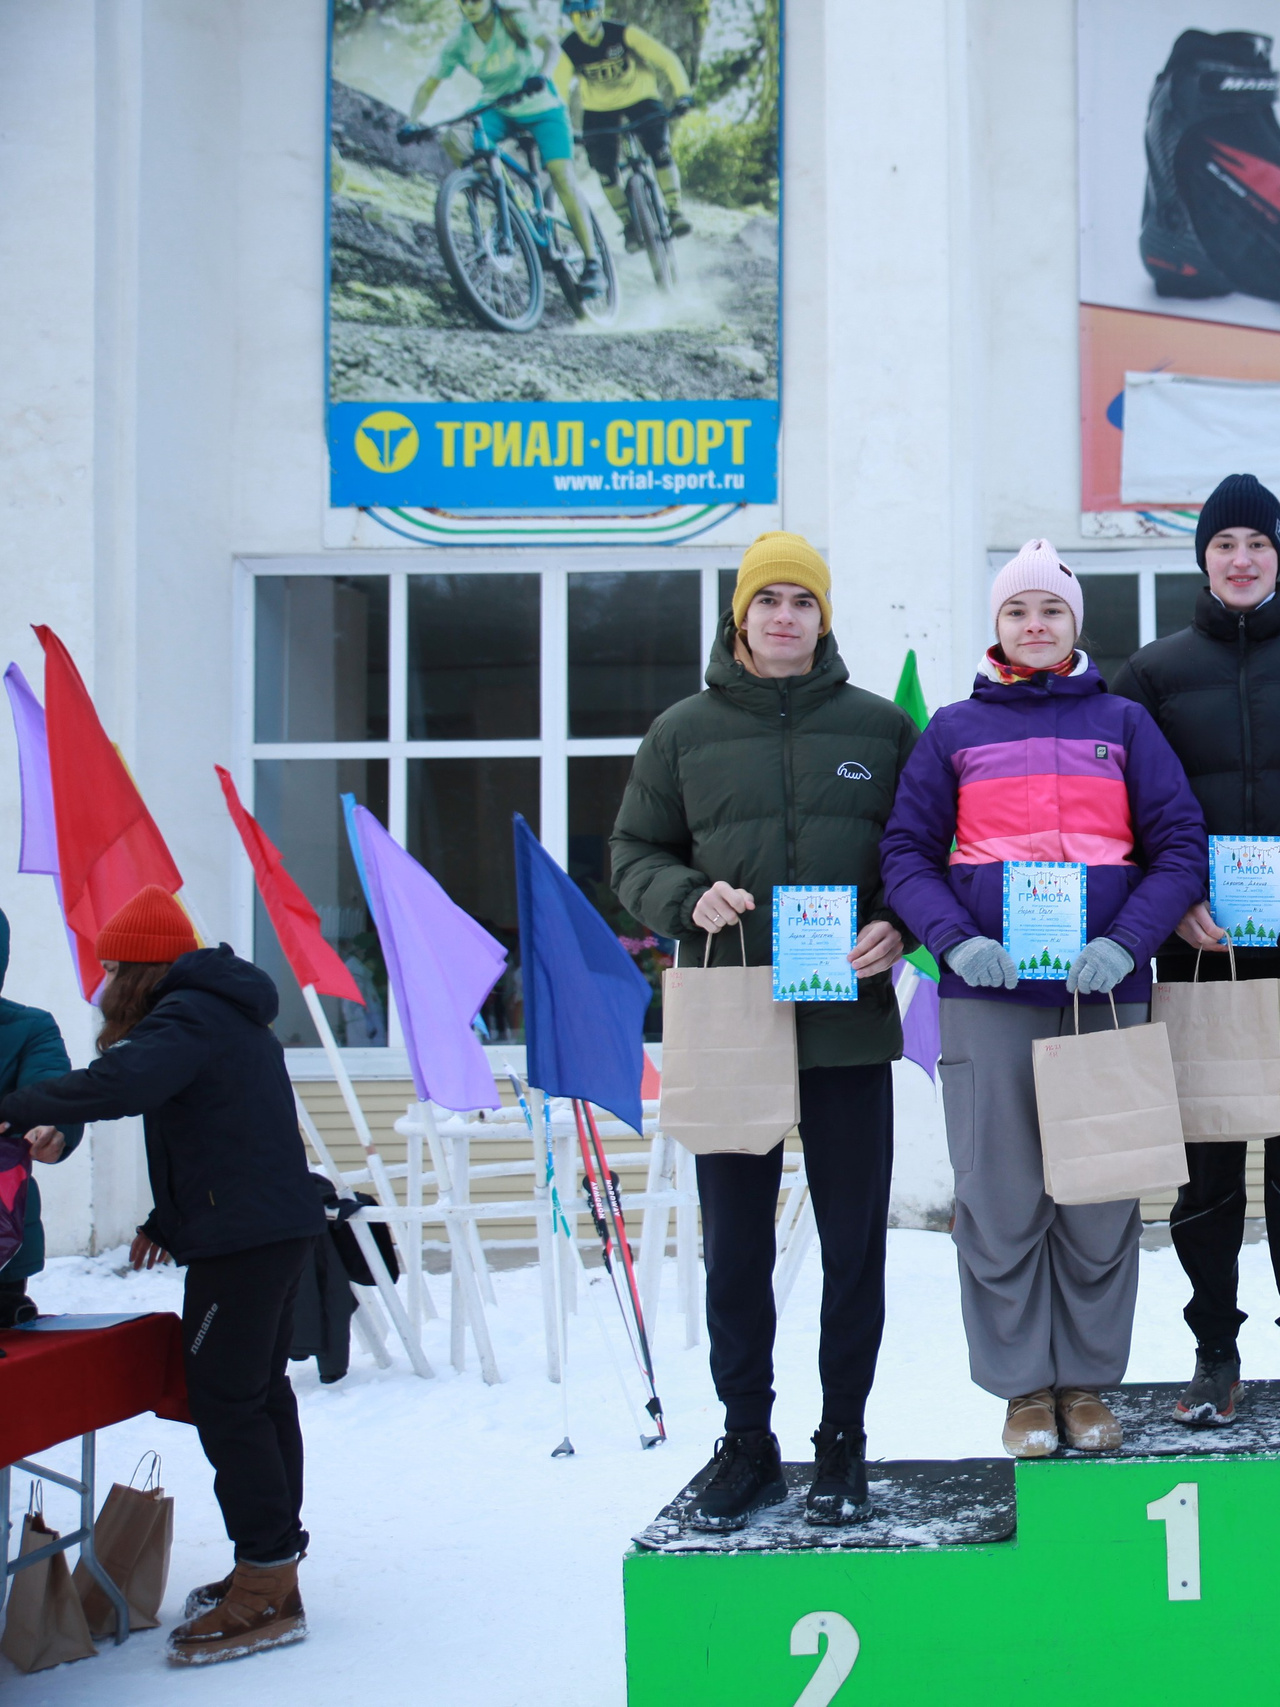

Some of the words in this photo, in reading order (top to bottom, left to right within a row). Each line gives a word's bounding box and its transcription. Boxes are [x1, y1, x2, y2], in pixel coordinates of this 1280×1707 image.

[554, 470, 745, 493] www.trial-sport.ru
[1223, 865, 1274, 875] ГРАМОТА
[1018, 893, 1071, 902] ГРАМОТА
[788, 917, 841, 926] ГРАМОТА
[590, 1181, 606, 1220] NORDWAY
[606, 1179, 620, 1217] NORDWAY
[190, 1303, 219, 1355] noname
[1147, 1482, 1200, 1601] 1
[789, 1612, 859, 1707] 2
